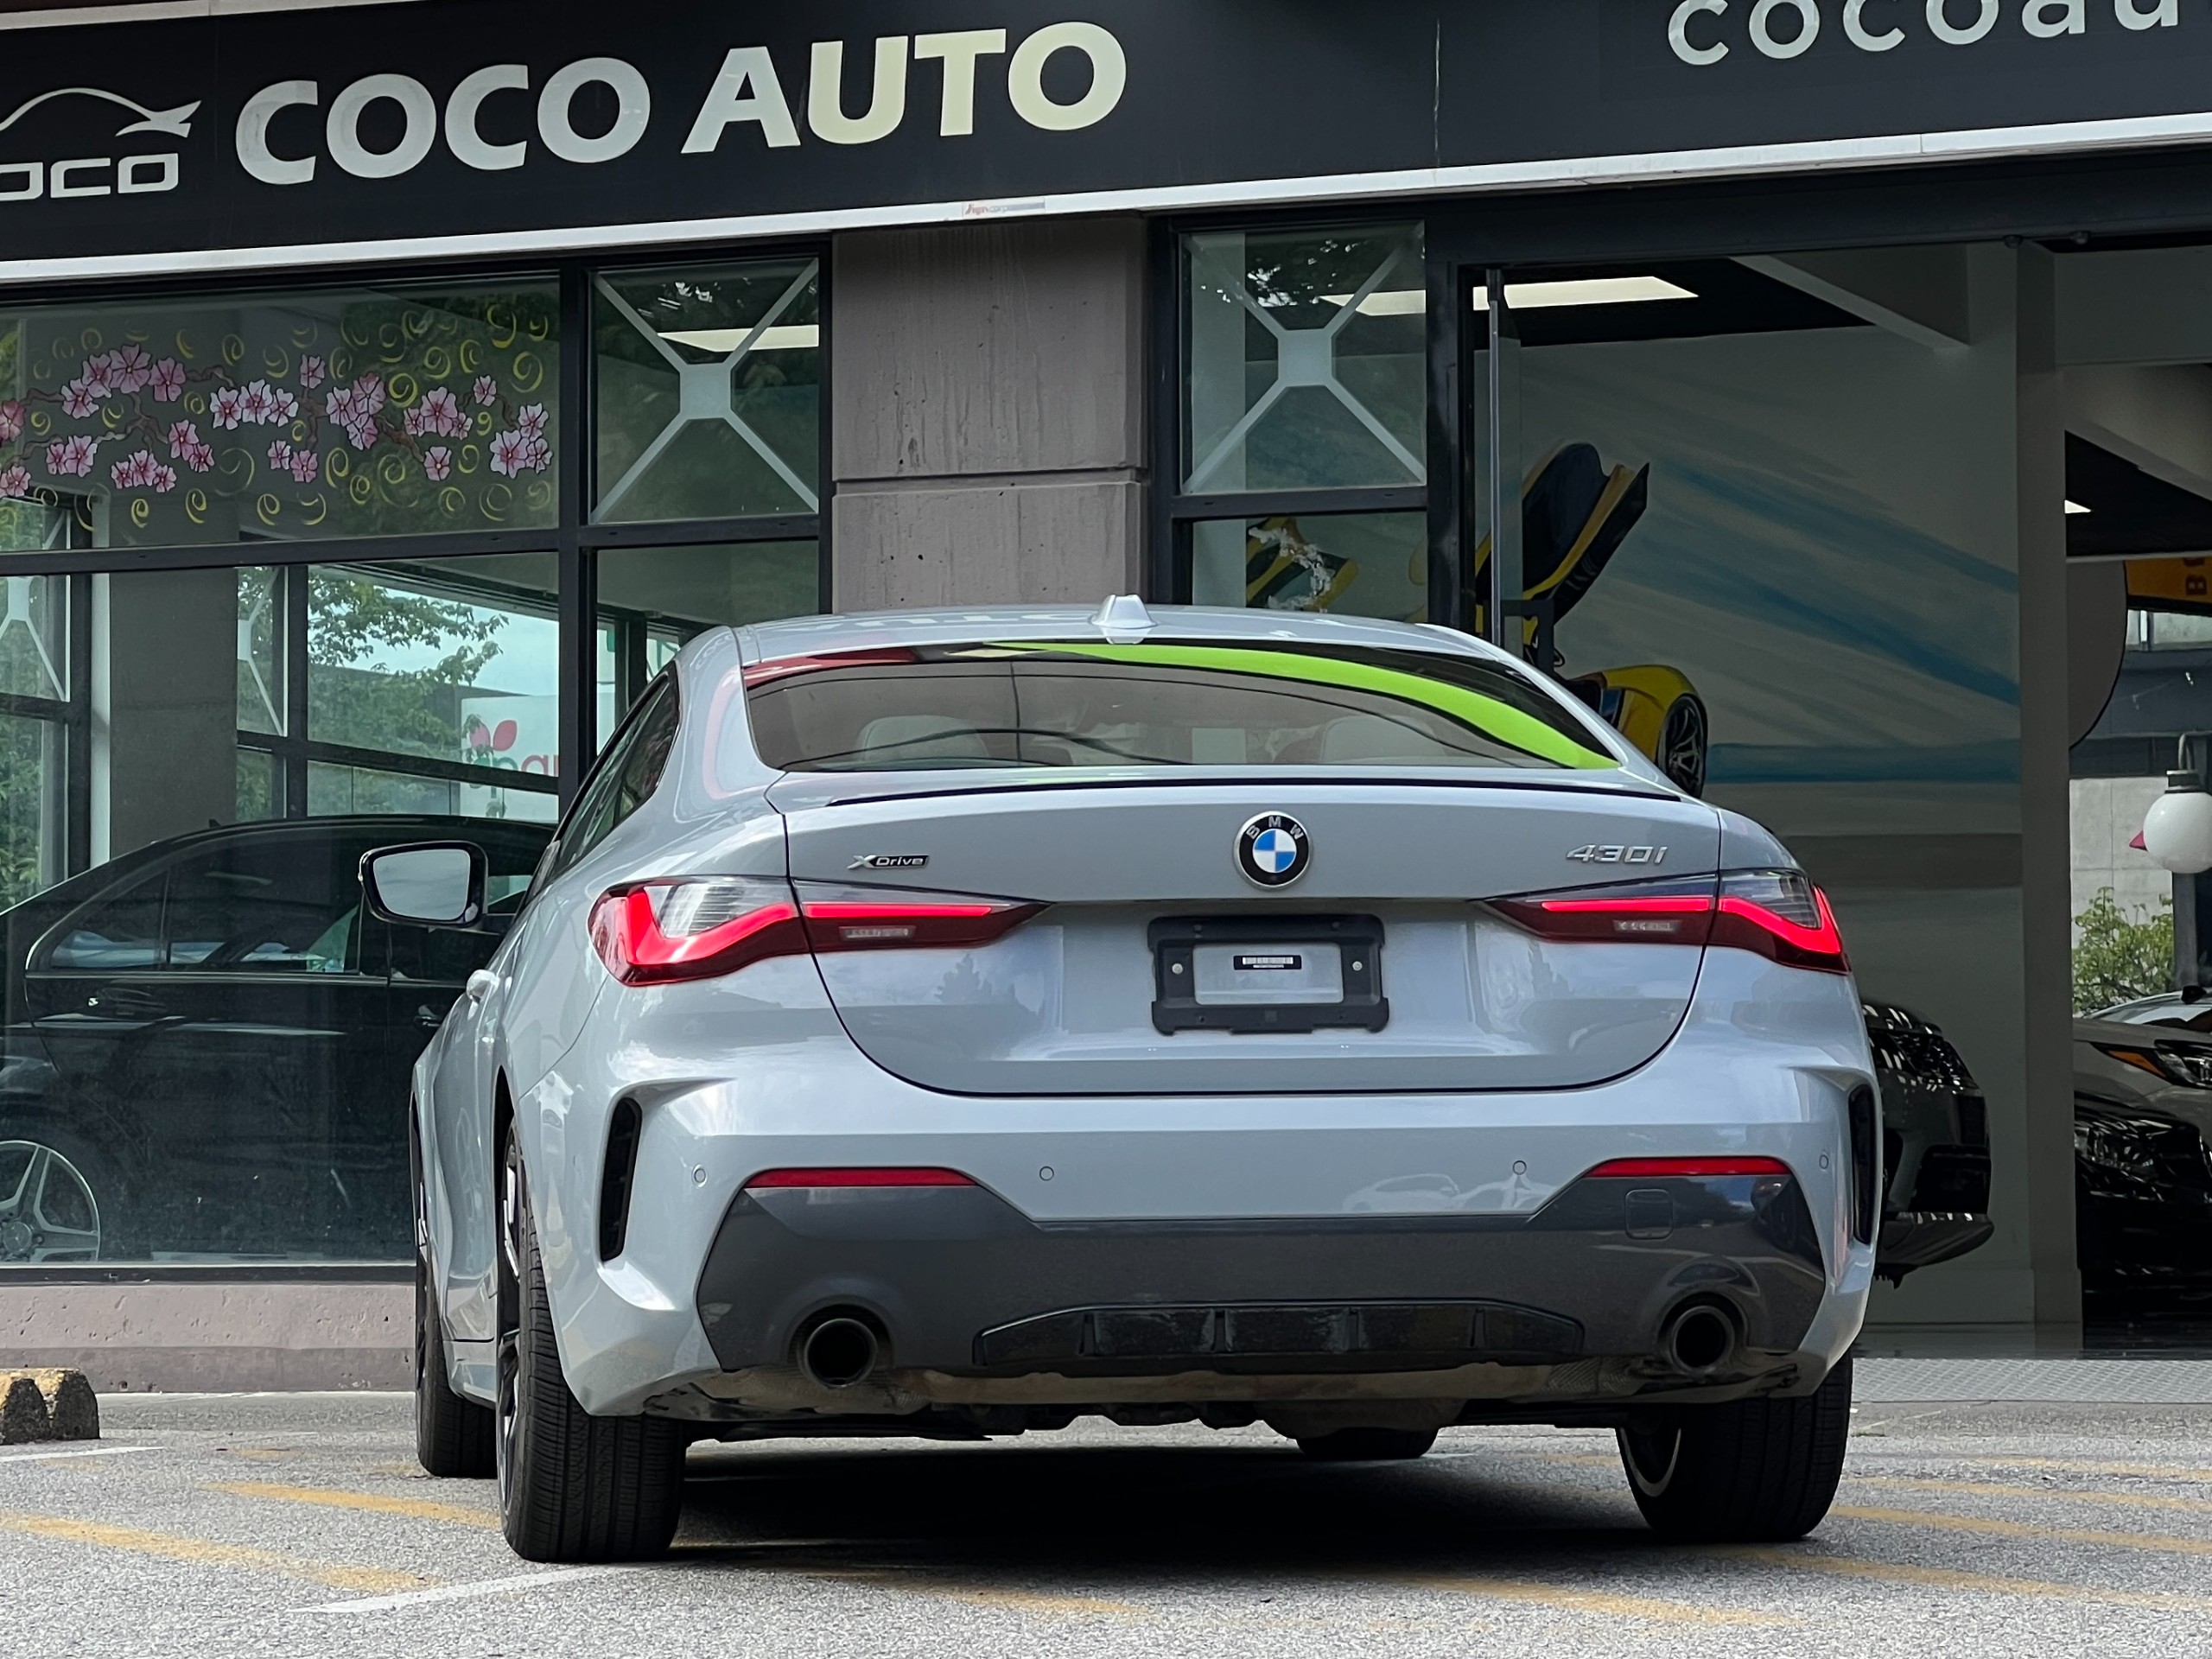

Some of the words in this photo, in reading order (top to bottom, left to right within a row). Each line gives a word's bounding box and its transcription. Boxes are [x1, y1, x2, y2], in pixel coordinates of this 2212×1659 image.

[235, 56, 651, 185] COCO
[681, 21, 1127, 154] AUTO
[1246, 816, 1304, 840] BMW
[1566, 844, 1669, 865] 430i
